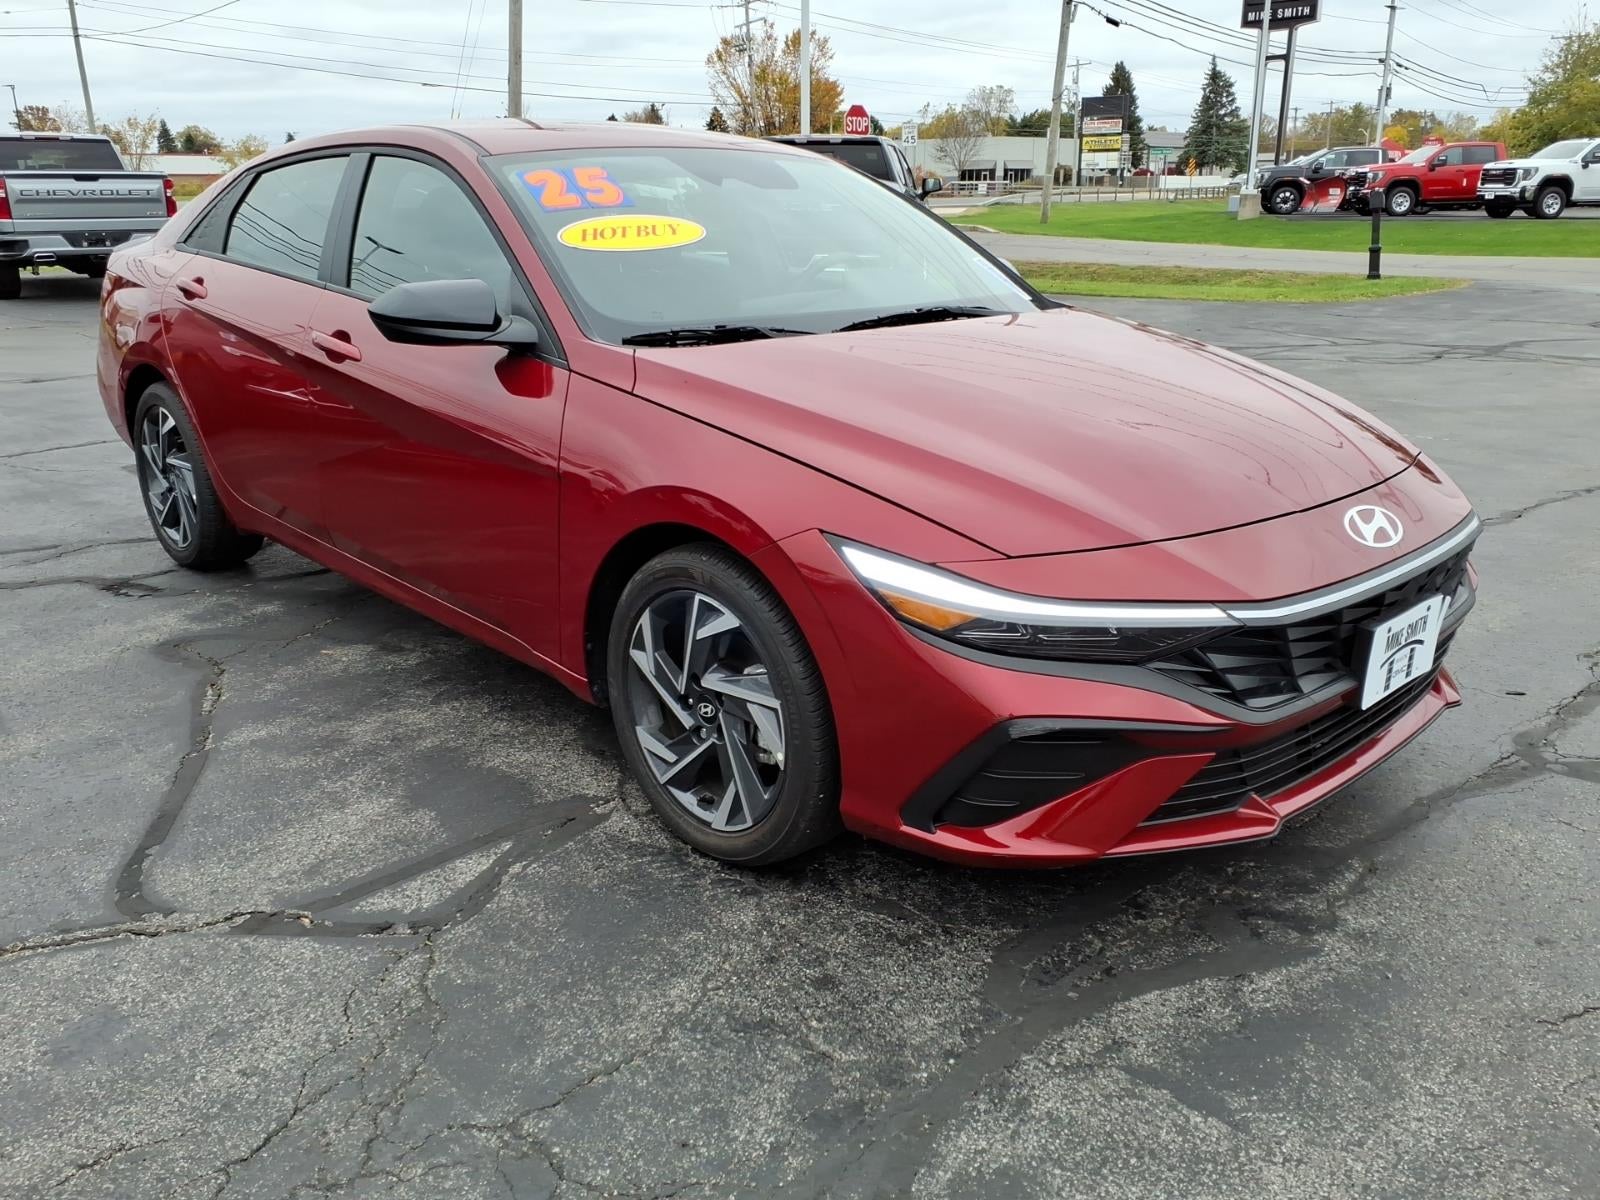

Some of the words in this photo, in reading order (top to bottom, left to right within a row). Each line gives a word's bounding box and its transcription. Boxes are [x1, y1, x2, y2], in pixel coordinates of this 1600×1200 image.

[1277, 6, 1310, 18] SMITH
[846, 117, 868, 131] STOP
[904, 135, 916, 144] 45
[20, 189, 154, 197] CHEVROLET
[524, 167, 623, 208] 25
[580, 224, 632, 242] HOT
[636, 223, 680, 238] BUY
[1384, 627, 1405, 654] MIKE
[1405, 615, 1428, 642] SMITH
